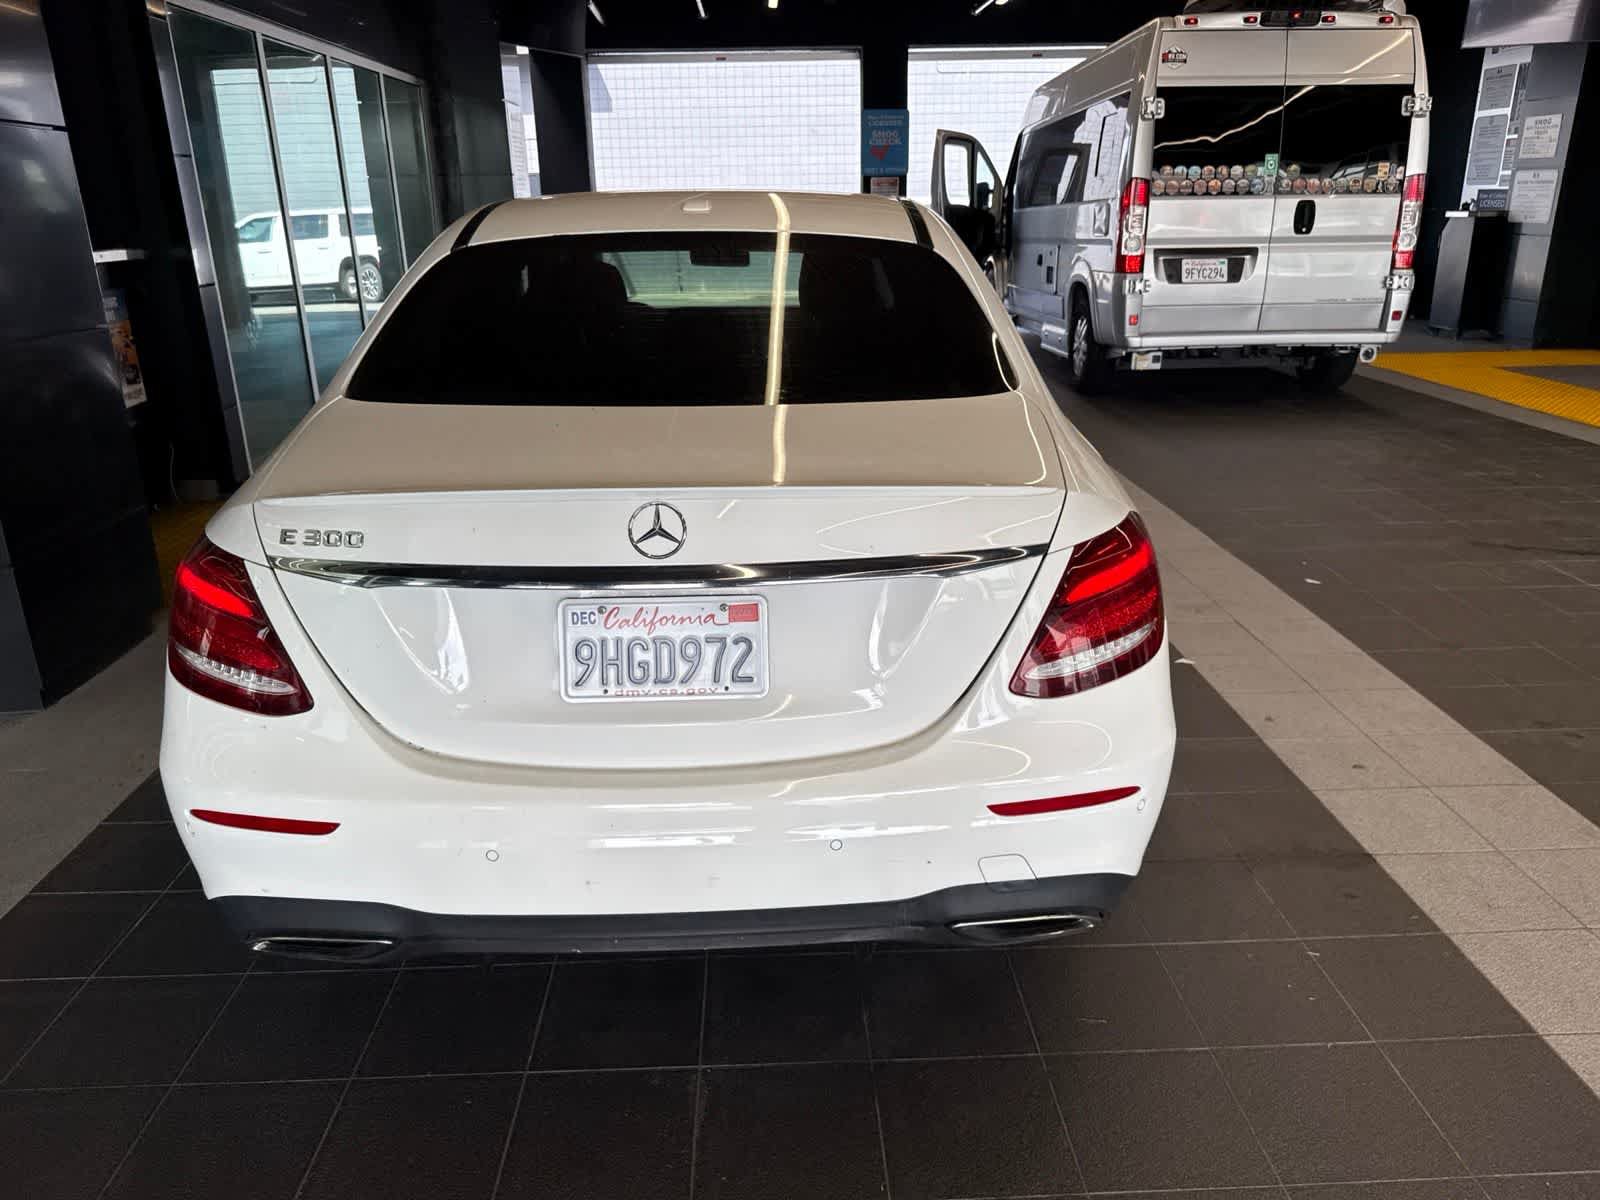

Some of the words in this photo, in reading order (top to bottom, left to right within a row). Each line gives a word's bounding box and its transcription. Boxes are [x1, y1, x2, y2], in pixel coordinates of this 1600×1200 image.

[1185, 267, 1225, 280] 9FYC294
[279, 528, 297, 545] E
[302, 530, 365, 549] 300
[571, 611, 597, 625] DEC
[603, 606, 730, 635] California
[574, 634, 755, 687] 9HGD972
